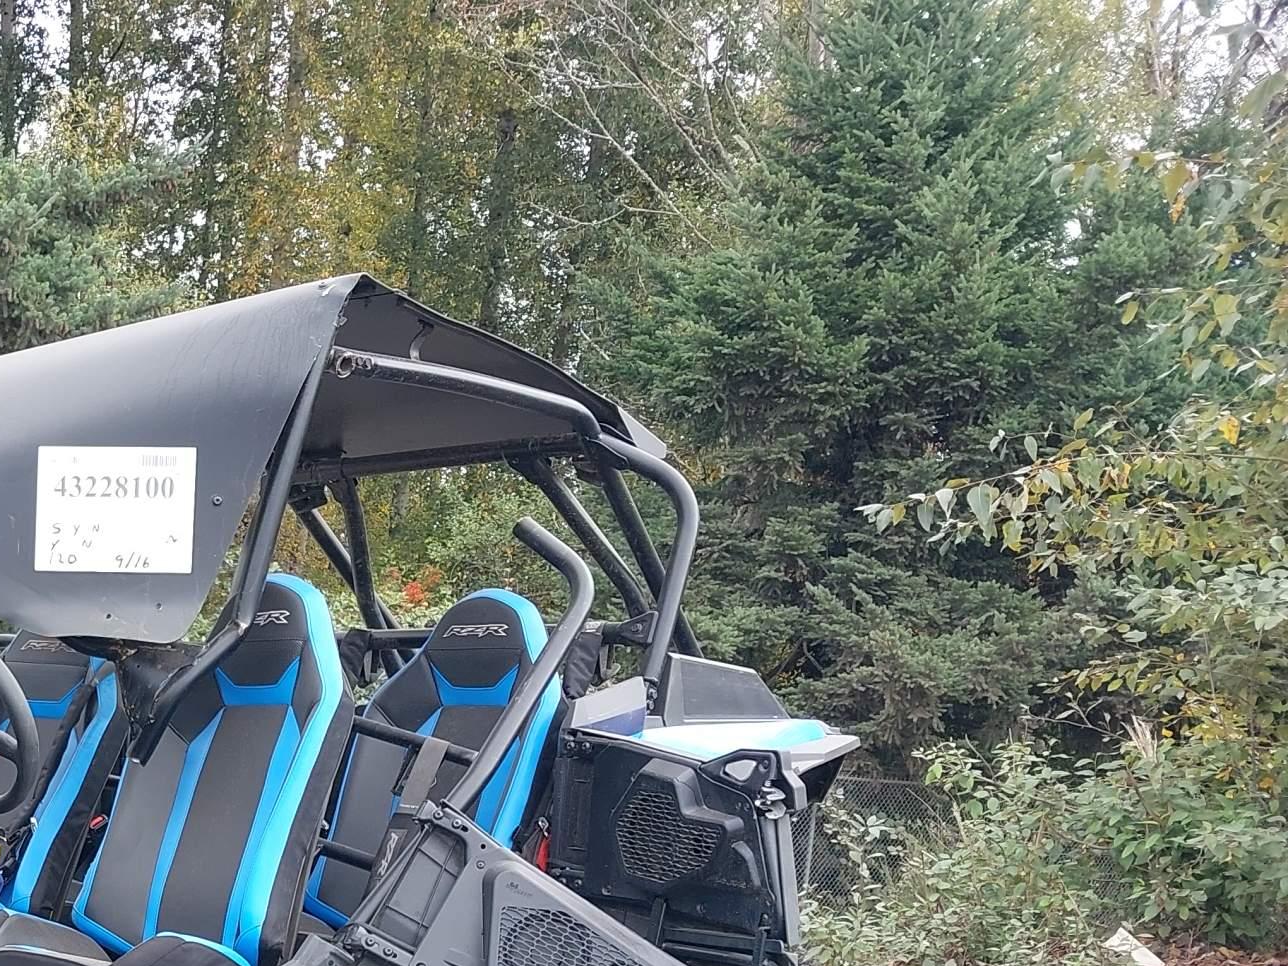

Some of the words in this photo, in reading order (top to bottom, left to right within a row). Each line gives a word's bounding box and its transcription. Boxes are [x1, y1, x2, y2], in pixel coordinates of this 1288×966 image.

[54, 476, 175, 498] 43228100
[52, 523, 61, 534] S
[115, 552, 150, 568] 9/16
[442, 623, 510, 638] RZR
